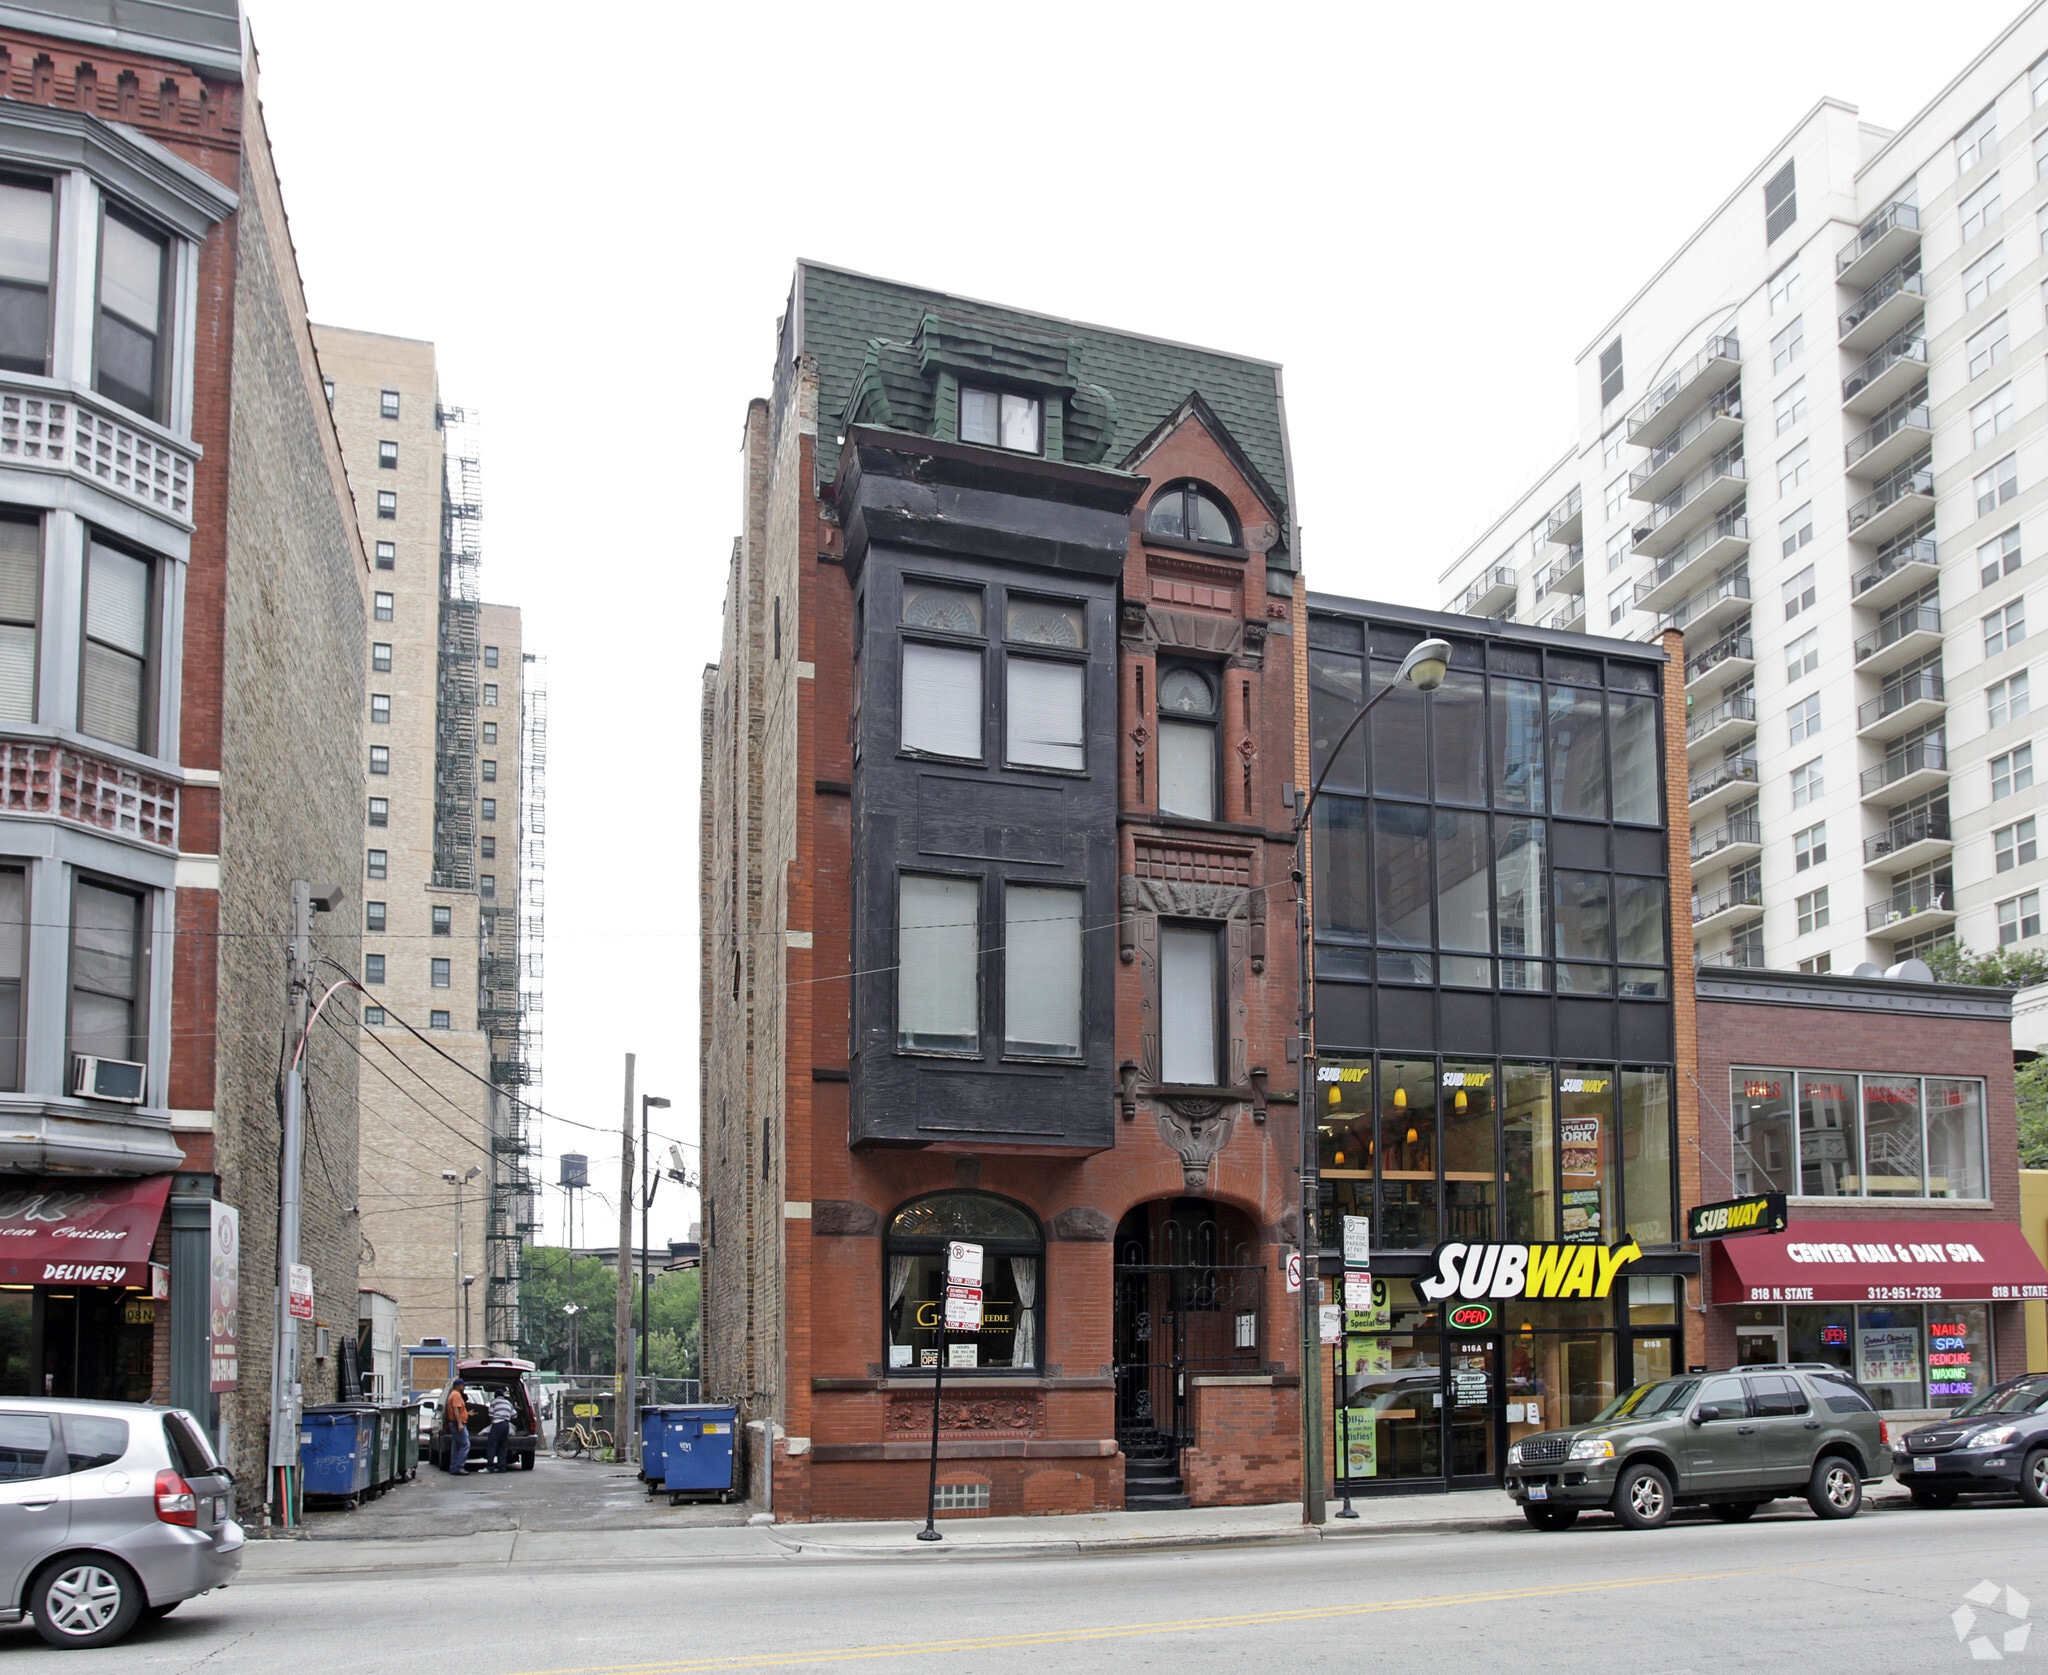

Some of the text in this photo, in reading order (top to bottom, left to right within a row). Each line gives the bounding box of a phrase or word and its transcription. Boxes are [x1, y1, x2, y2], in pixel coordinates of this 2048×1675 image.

[1317, 1066, 1369, 1083] SUBWAY
[1442, 1071, 1492, 1087] SUBWAY
[1560, 1078, 1608, 1093] SUBWAY
[1744, 1080, 1782, 1099] NAILS
[1805, 1083, 1847, 1101] FACIAL
[1863, 1085, 1918, 1104] MASSAGE
[1566, 1124, 1596, 1132] PULLED
[1561, 1131, 1592, 1142] ORK
[1694, 1200, 1768, 1234] SUBWAY
[52, 1226, 128, 1240] Cuisine
[1786, 1243, 1986, 1263] CENTER NAIL & DAY SPA
[42, 1264, 126, 1283] DELIVERY
[1420, 1240, 1643, 1301] SUBWAY
[1751, 1288, 1813, 1300] 818 N. STATE
[1867, 1286, 1942, 1299] 312-951-7332
[1992, 1286, 2048, 1297] 818 N. STATE
[1355, 1310, 1371, 1318] Daily
[1455, 1310, 1487, 1323] OPEN
[1350, 1320, 1375, 1328] Special
[1931, 1323, 1967, 1336] NAILS
[1823, 1329, 1847, 1342] OPEN
[1935, 1338, 1964, 1350] SPA
[922, 1356, 938, 1364] OPE
[1929, 1352, 1972, 1365] PEDICURE
[1932, 1368, 1966, 1380] WAXING
[1930, 1382, 1973, 1395] SKIN CARE
[1339, 1432, 1373, 1441] stisfies!
